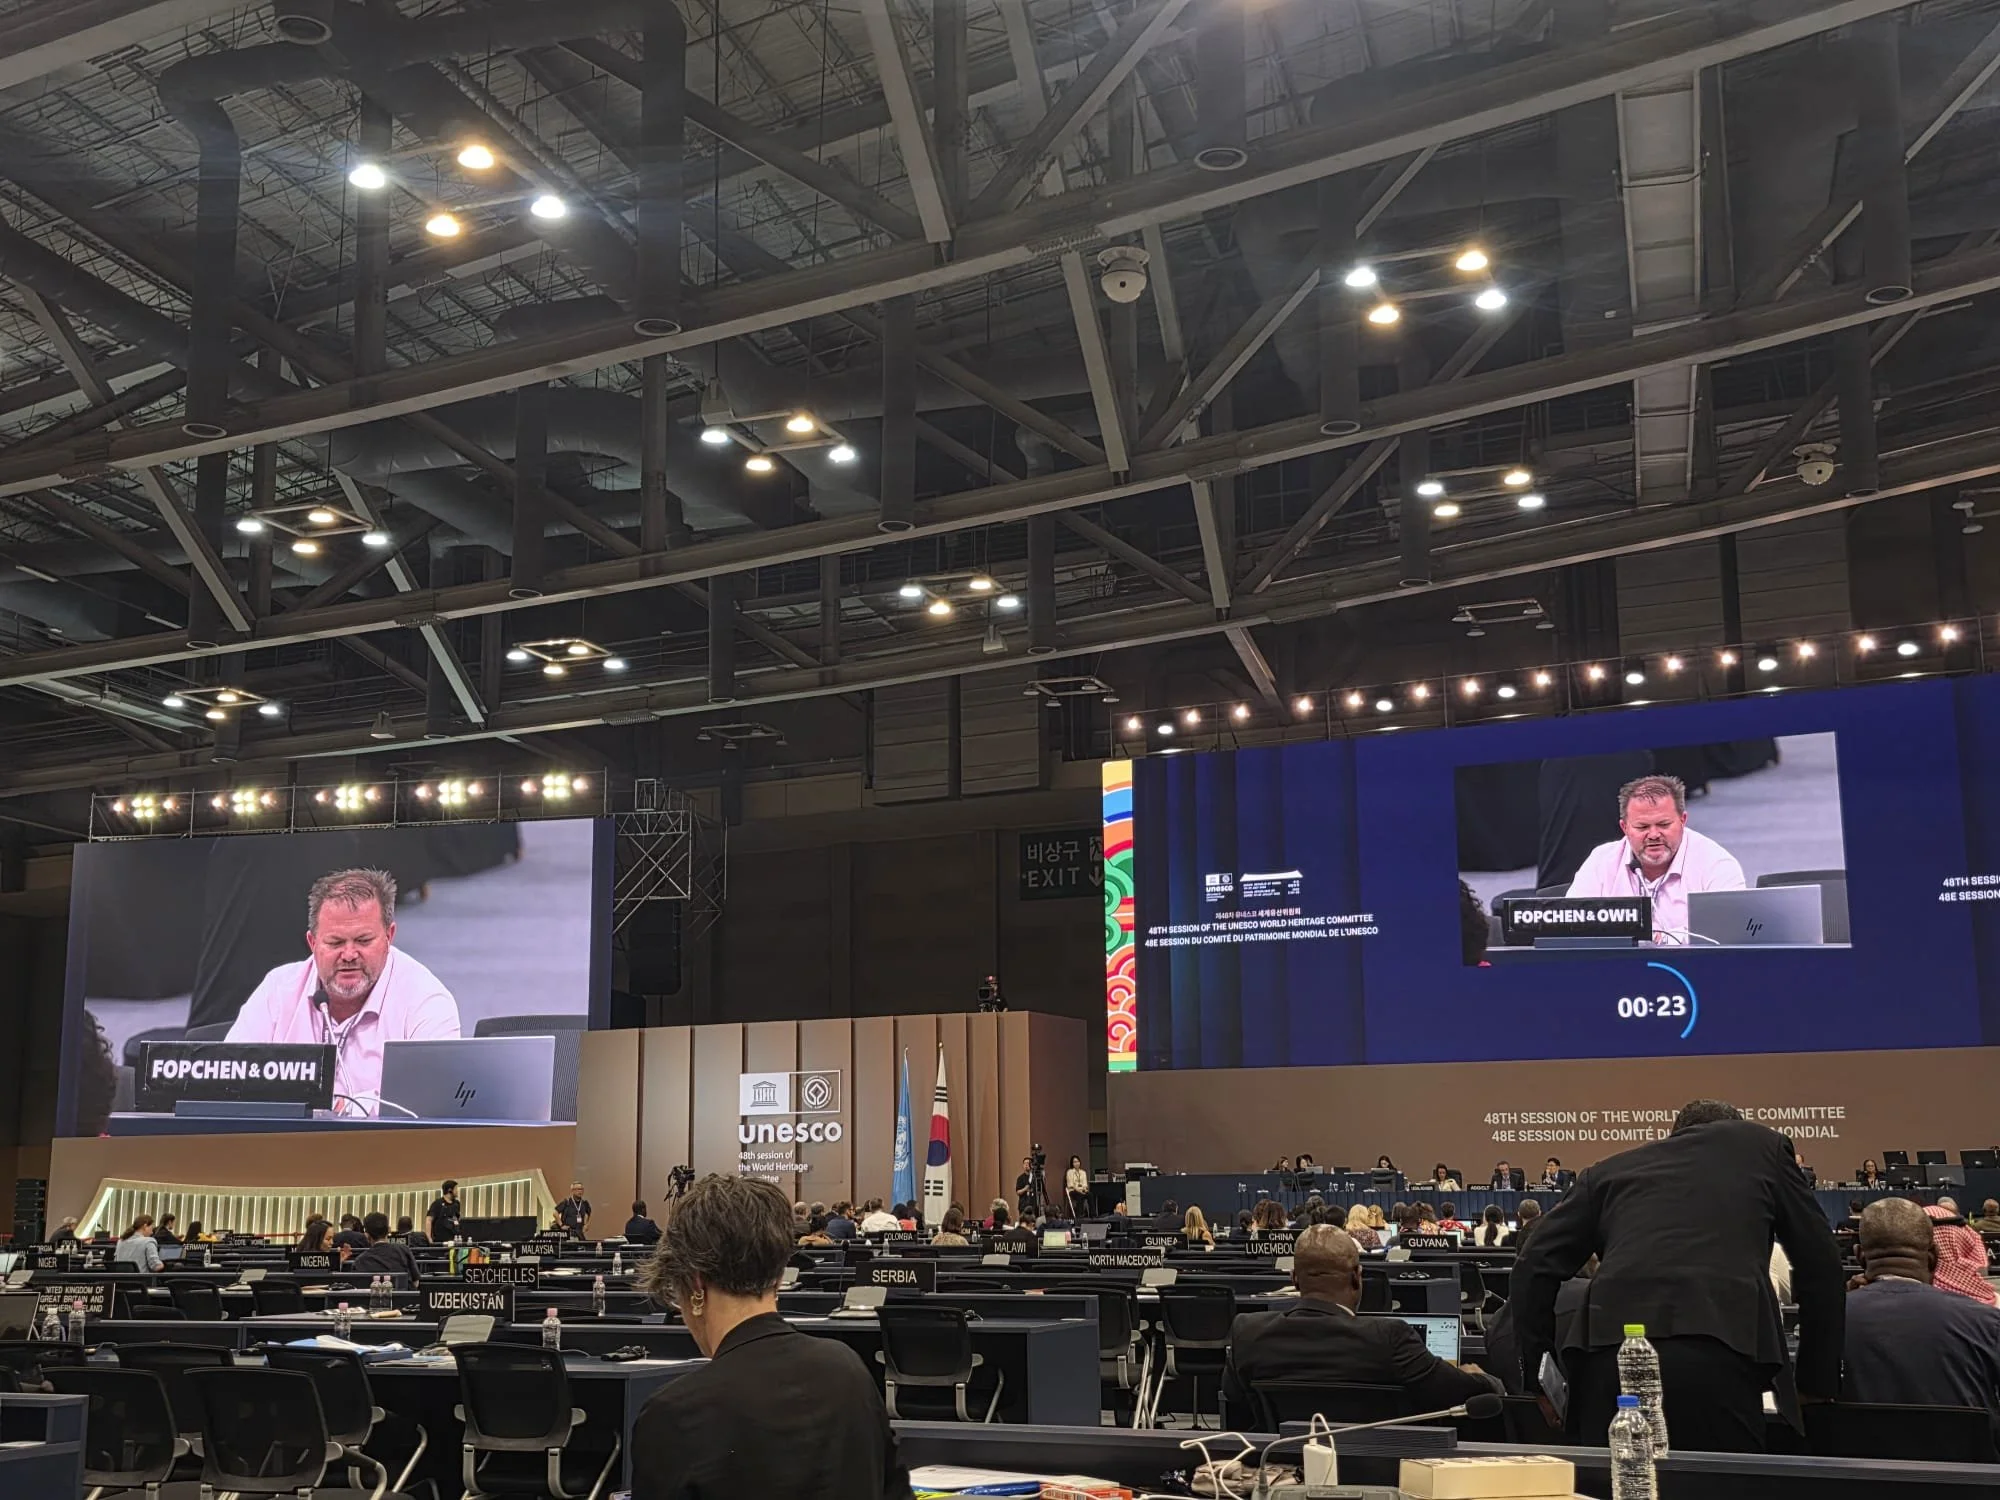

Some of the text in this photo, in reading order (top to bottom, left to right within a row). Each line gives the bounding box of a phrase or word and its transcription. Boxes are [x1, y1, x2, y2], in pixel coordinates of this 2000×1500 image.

[1027, 841, 1080, 863] 비상구
[1028, 867, 1080, 888] EXIT
[1942, 876, 1969, 887] 48TH
[1938, 891, 1957, 902] 48E
[1513, 909, 1585, 924] FOPCHEN
[1597, 908, 1638, 922] OWH
[1148, 913, 1374, 935] 48TH SESSION OF THE UNESCO WORLD HERITAGE COMMITTEE
[1145, 926, 1378, 947] 48E SESSION DU COMITÉ DU PATRIMOINE MONDIAL DE L'UNESCO
[1617, 996, 1686, 1018] 00:23
[152, 1059, 247, 1080] FOPCHEN
[263, 1060, 316, 1081] OWH
[1484, 1112, 1517, 1125] 48TH
[1520, 1111, 1577, 1124] SESSION
[1580, 1111, 1598, 1123] OF
[1602, 1110, 1630, 1123] THE
[1757, 1106, 1846, 1120] COMMITTEE
[738, 1121, 842, 1144] unesco
[1491, 1130, 1516, 1142] 48E
[1519, 1129, 1575, 1142] SESSION
[1579, 1129, 1597, 1141] DU
[1601, 1126, 1654, 1141] COMITÉ
[738, 1149, 793, 1160] 48th session of
[738, 1162, 808, 1173] the World Heritage
[884, 1233, 913, 1241] COLOMBIA
[1268, 1232, 1294, 1241] CHINA
[994, 1242, 1026, 1253] MALAWI
[1245, 1242, 1295, 1254] LUXEMBOU
[1408, 1238, 1449, 1248] GUYANA
[521, 1244, 555, 1255] MALAYSIA
[38, 1257, 58, 1268] NIGER
[300, 1255, 331, 1267] NIGERIA
[1089, 1253, 1162, 1266] NORTH MACEDONIA
[465, 1268, 536, 1283] SEYCHELLES
[872, 1269, 917, 1284] SERBIA
[65, 1286, 93, 1294] KINGDOM
[96, 1286, 104, 1294] OF
[40, 1295, 61, 1303] GREAT
[90, 1295, 105, 1303] AND
[429, 1292, 504, 1310] UZBEKISTAN
